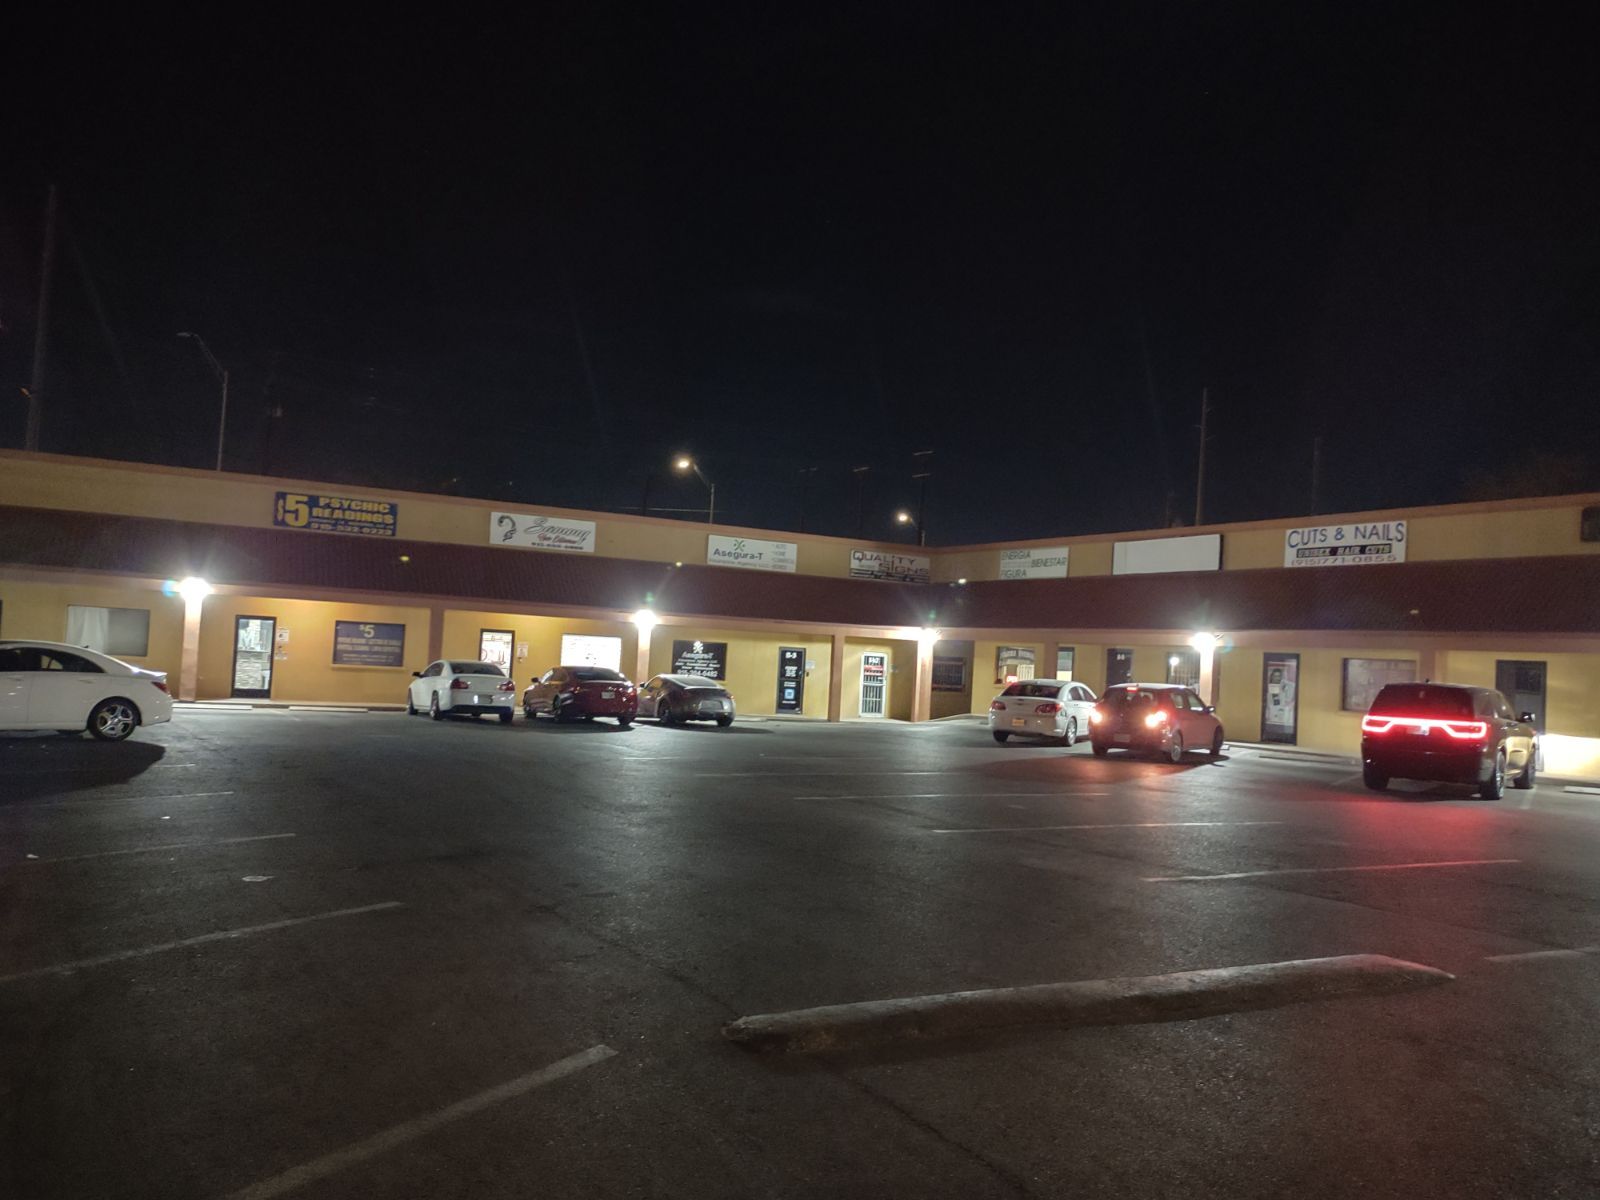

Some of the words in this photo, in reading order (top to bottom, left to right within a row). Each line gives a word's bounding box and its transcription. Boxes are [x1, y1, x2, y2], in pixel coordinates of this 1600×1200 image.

[277, 494, 309, 527] $5
[319, 497, 390, 513] PSYCHIC
[312, 507, 394, 524] READINGS
[1288, 528, 1327, 548] CUTS
[1334, 527, 1345, 540] &
[1354, 522, 1404, 542] NAILS
[713, 548, 764, 560] Asegura-T
[1031, 556, 1067, 568] BIENESTAR
